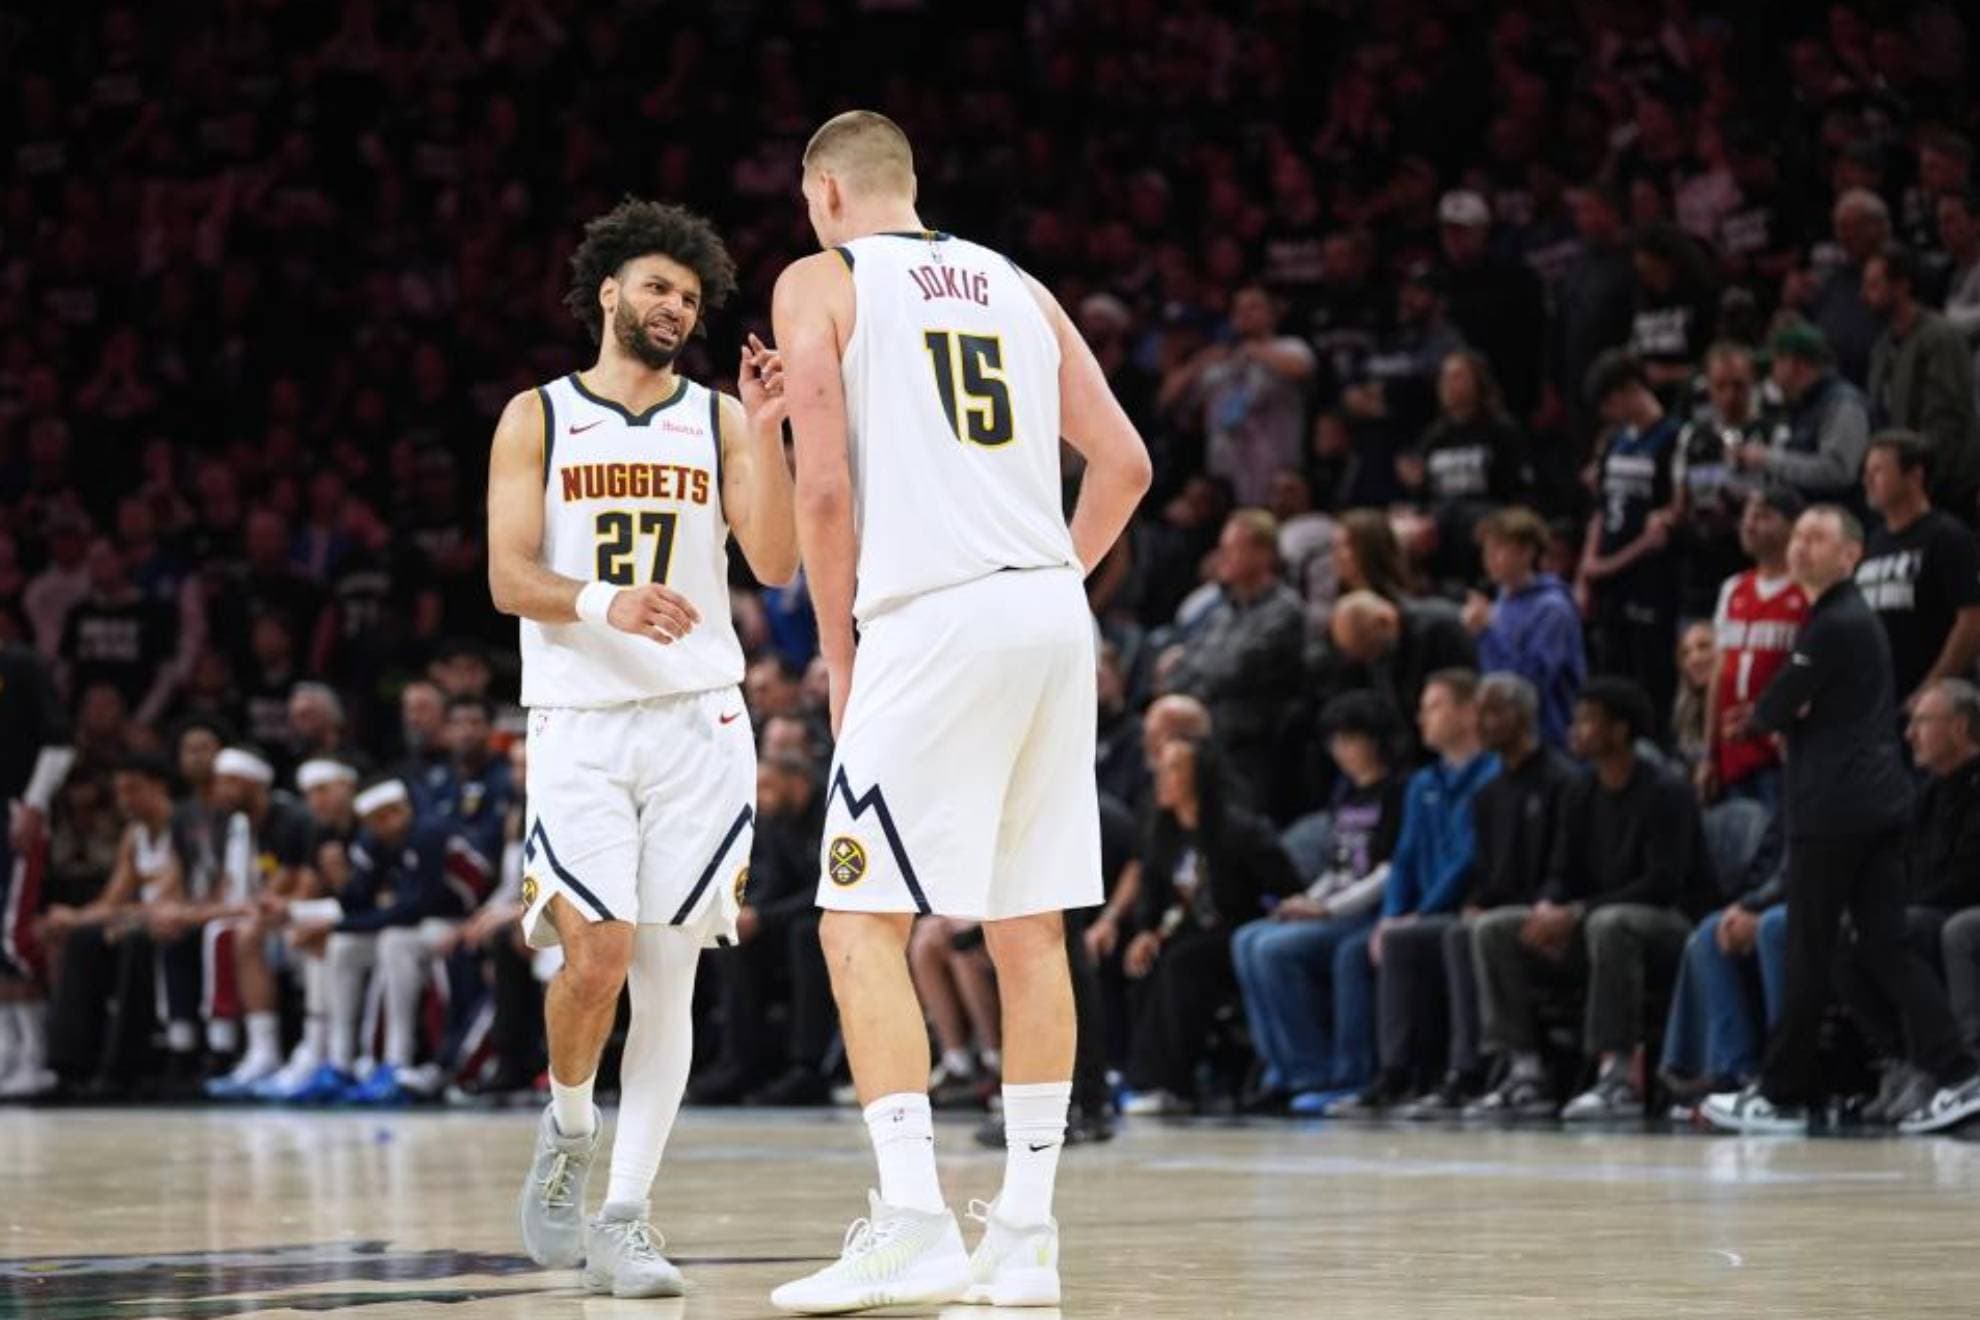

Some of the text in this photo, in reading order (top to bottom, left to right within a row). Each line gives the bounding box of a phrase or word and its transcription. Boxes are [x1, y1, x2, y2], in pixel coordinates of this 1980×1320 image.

[908, 264, 989, 307] JOKIĆ
[923, 328, 1015, 448] 15
[560, 463, 711, 506] NUGGETS
[594, 510, 679, 588] 27
